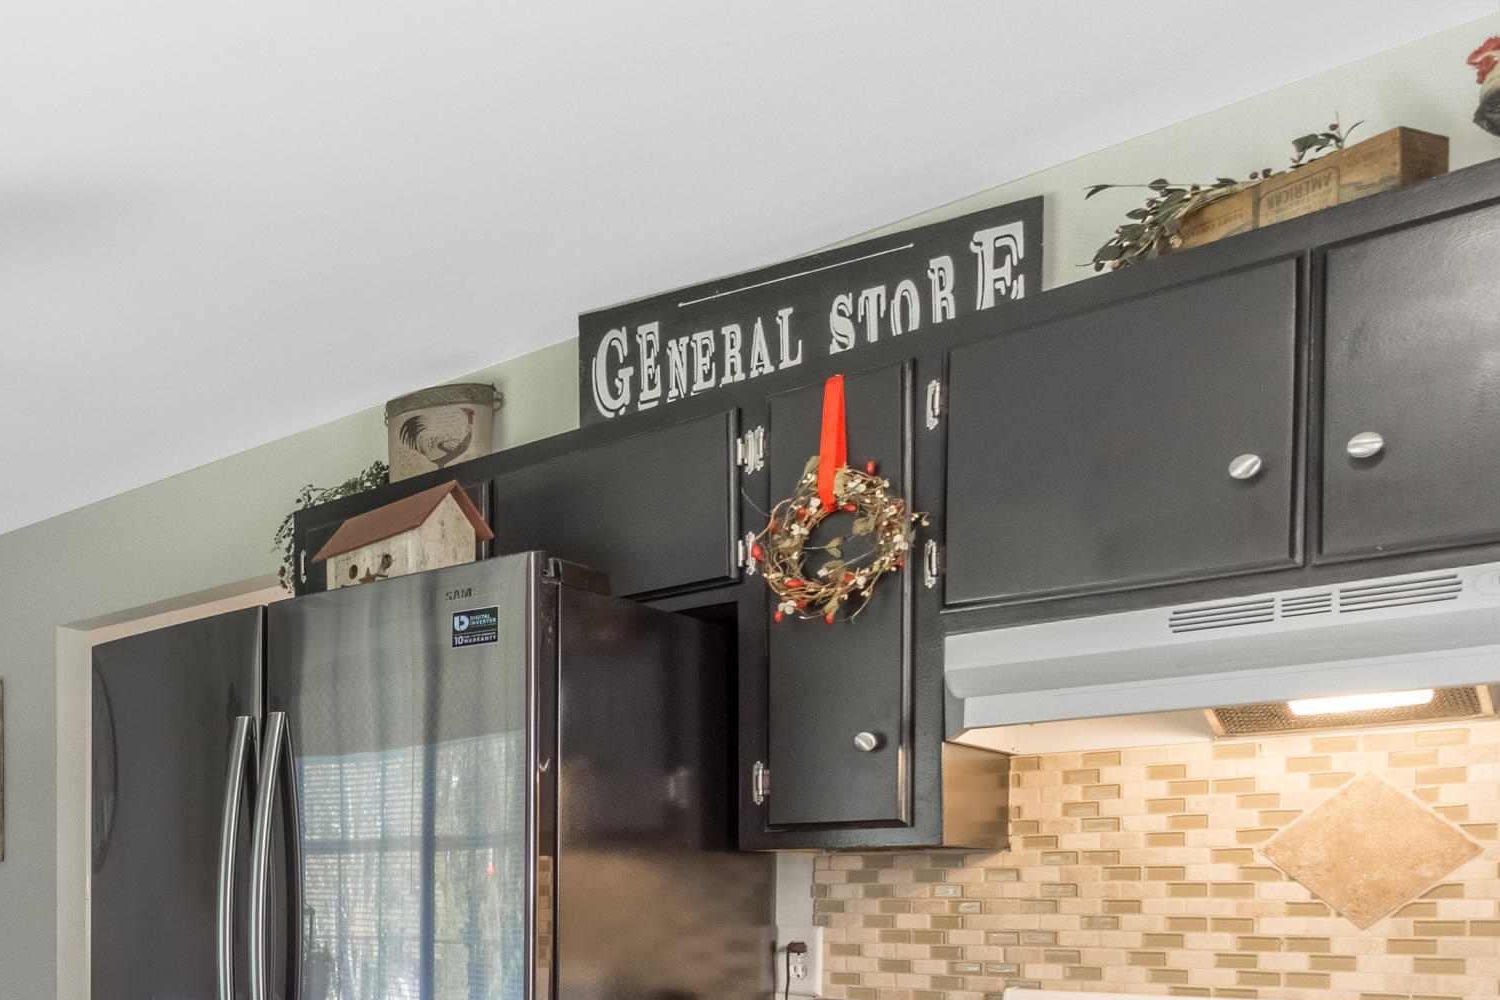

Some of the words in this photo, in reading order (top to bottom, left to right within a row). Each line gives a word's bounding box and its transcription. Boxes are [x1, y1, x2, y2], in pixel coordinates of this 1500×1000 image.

[592, 307, 802, 418] GENERAL
[829, 220, 1025, 356] STORE
[454, 635, 464, 646] 10
